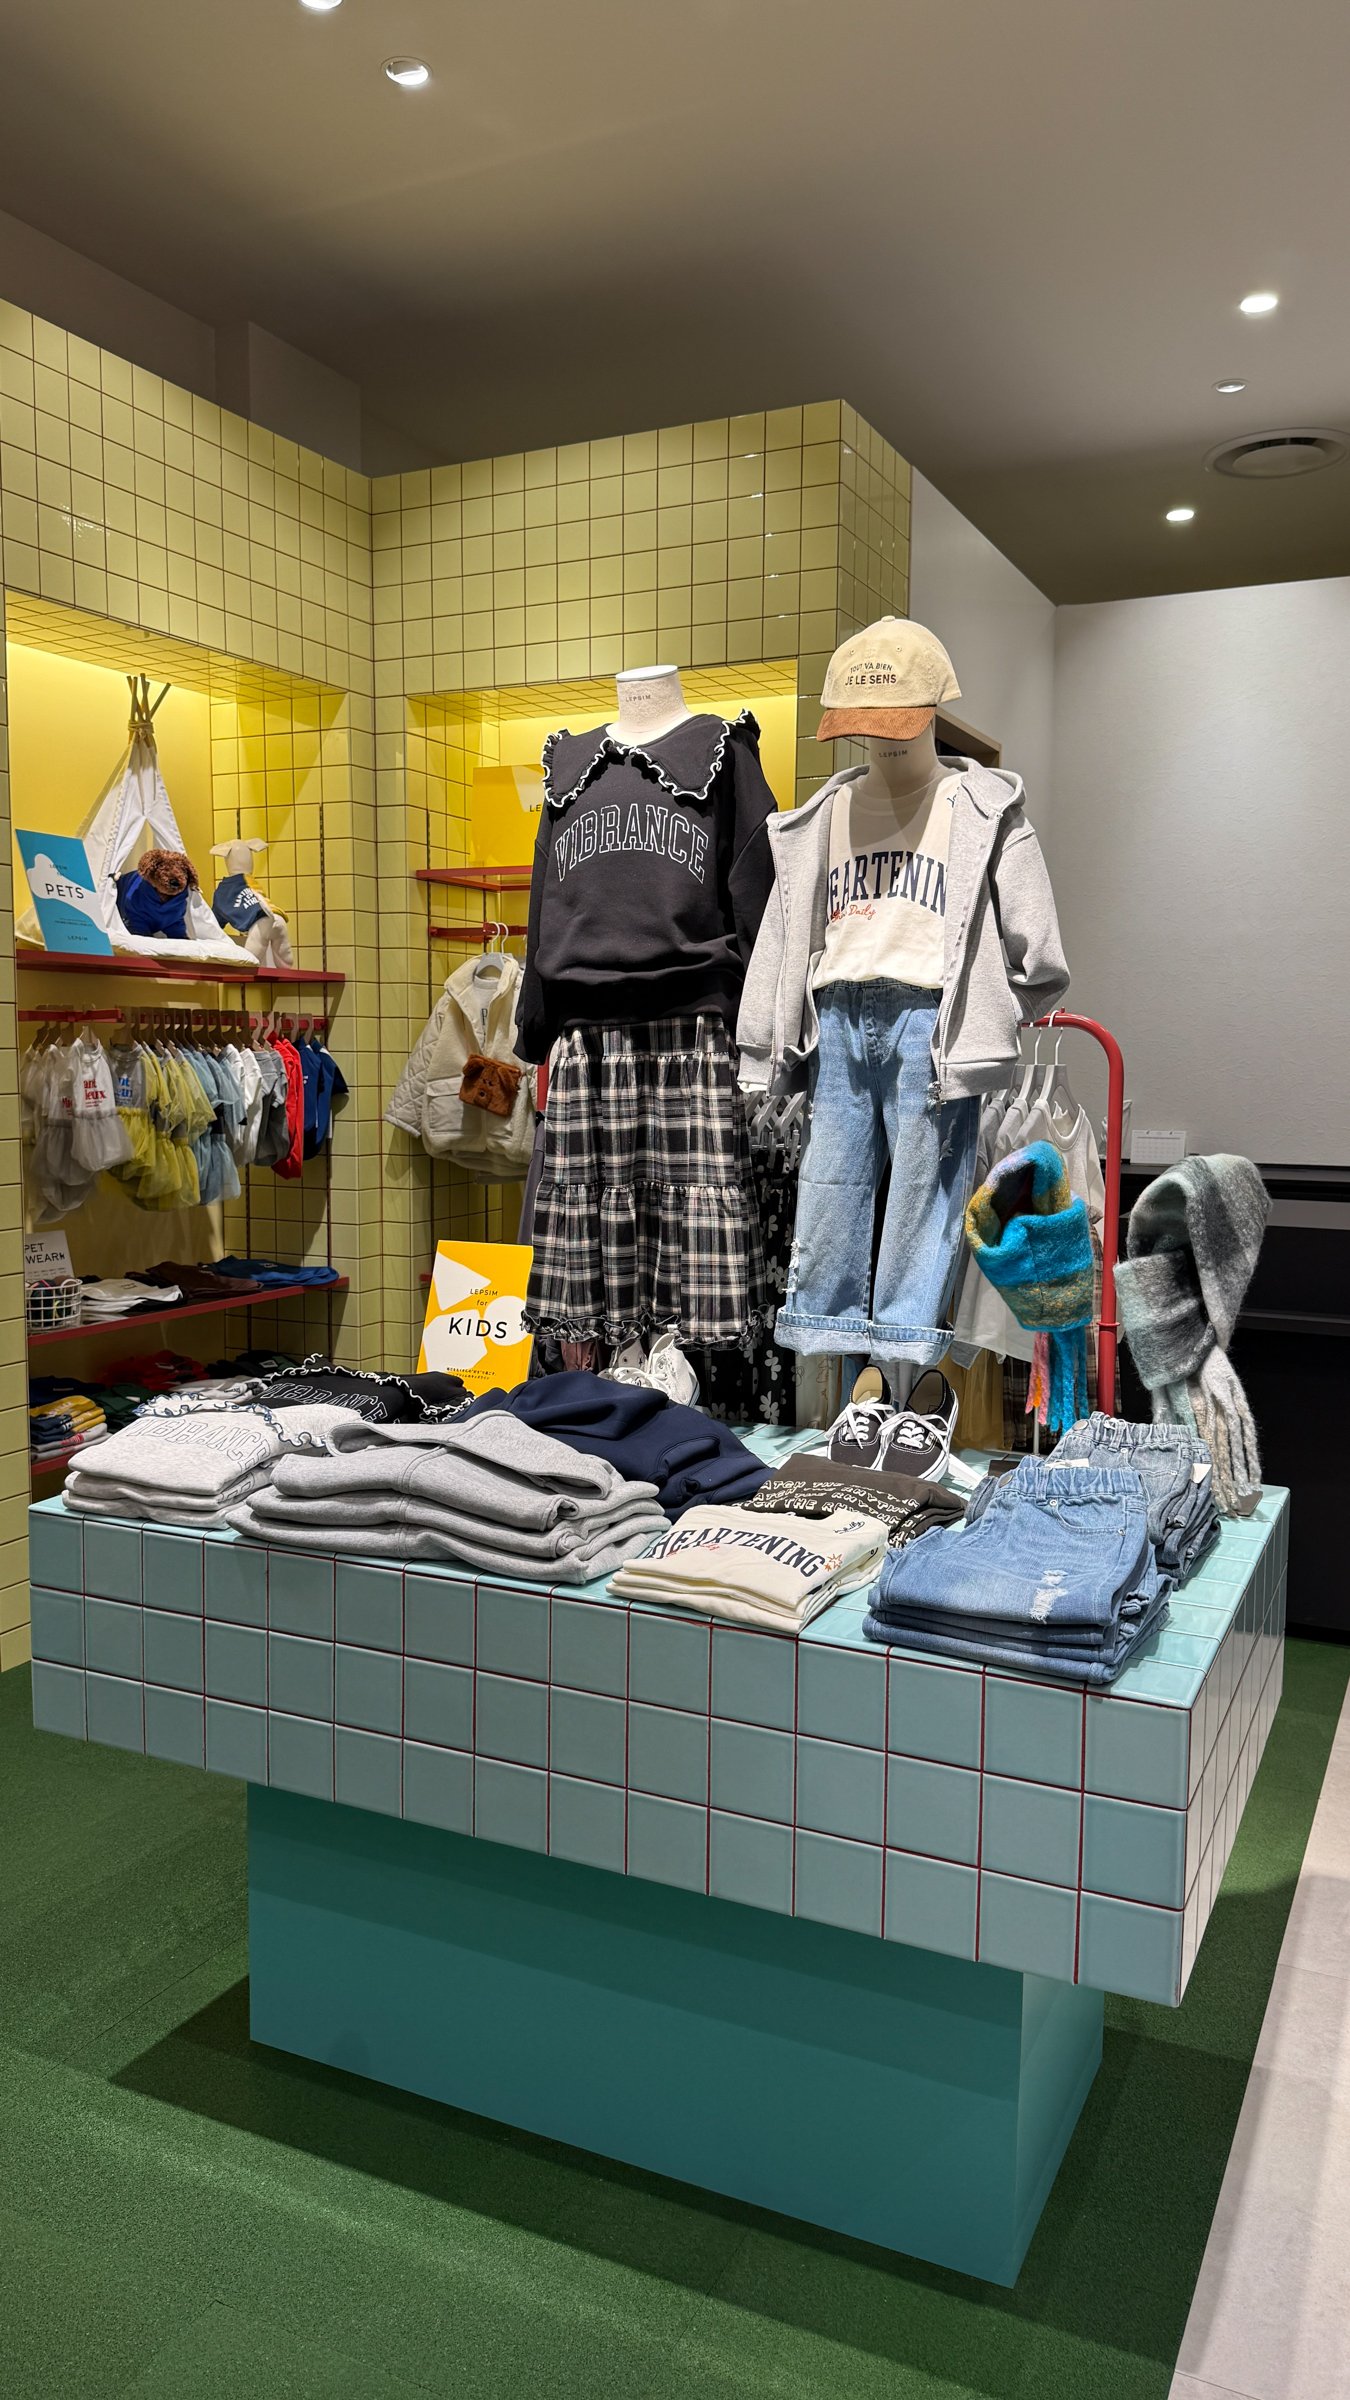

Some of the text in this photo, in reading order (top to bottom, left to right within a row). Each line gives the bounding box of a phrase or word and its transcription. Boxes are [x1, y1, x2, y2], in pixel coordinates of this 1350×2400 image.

[864, 662, 874, 670] VA
[875, 662, 893, 671] BIEN
[845, 674, 897, 686] JE LE SENS
[625, 694, 652, 703] LEPSIM
[878, 749, 908, 758] LEPSIM
[529, 804, 542, 813] LE
[555, 803, 709, 884] VIBRANCE
[45, 883, 84, 899] PETS
[827, 850, 948, 921] EARTENIN
[848, 904, 876, 921] Daily
[24, 1242, 45, 1254] PET
[25, 1252, 59, 1264] WEAR
[470, 1288, 499, 1296] LEPSIM
[448, 1317, 508, 1339] KIDS
[760, 1480, 807, 1490] ATCH
[752, 1487, 799, 1502] ATCH
[784, 1498, 818, 1510] THE
[642, 1527, 826, 1578] HEARTENING
